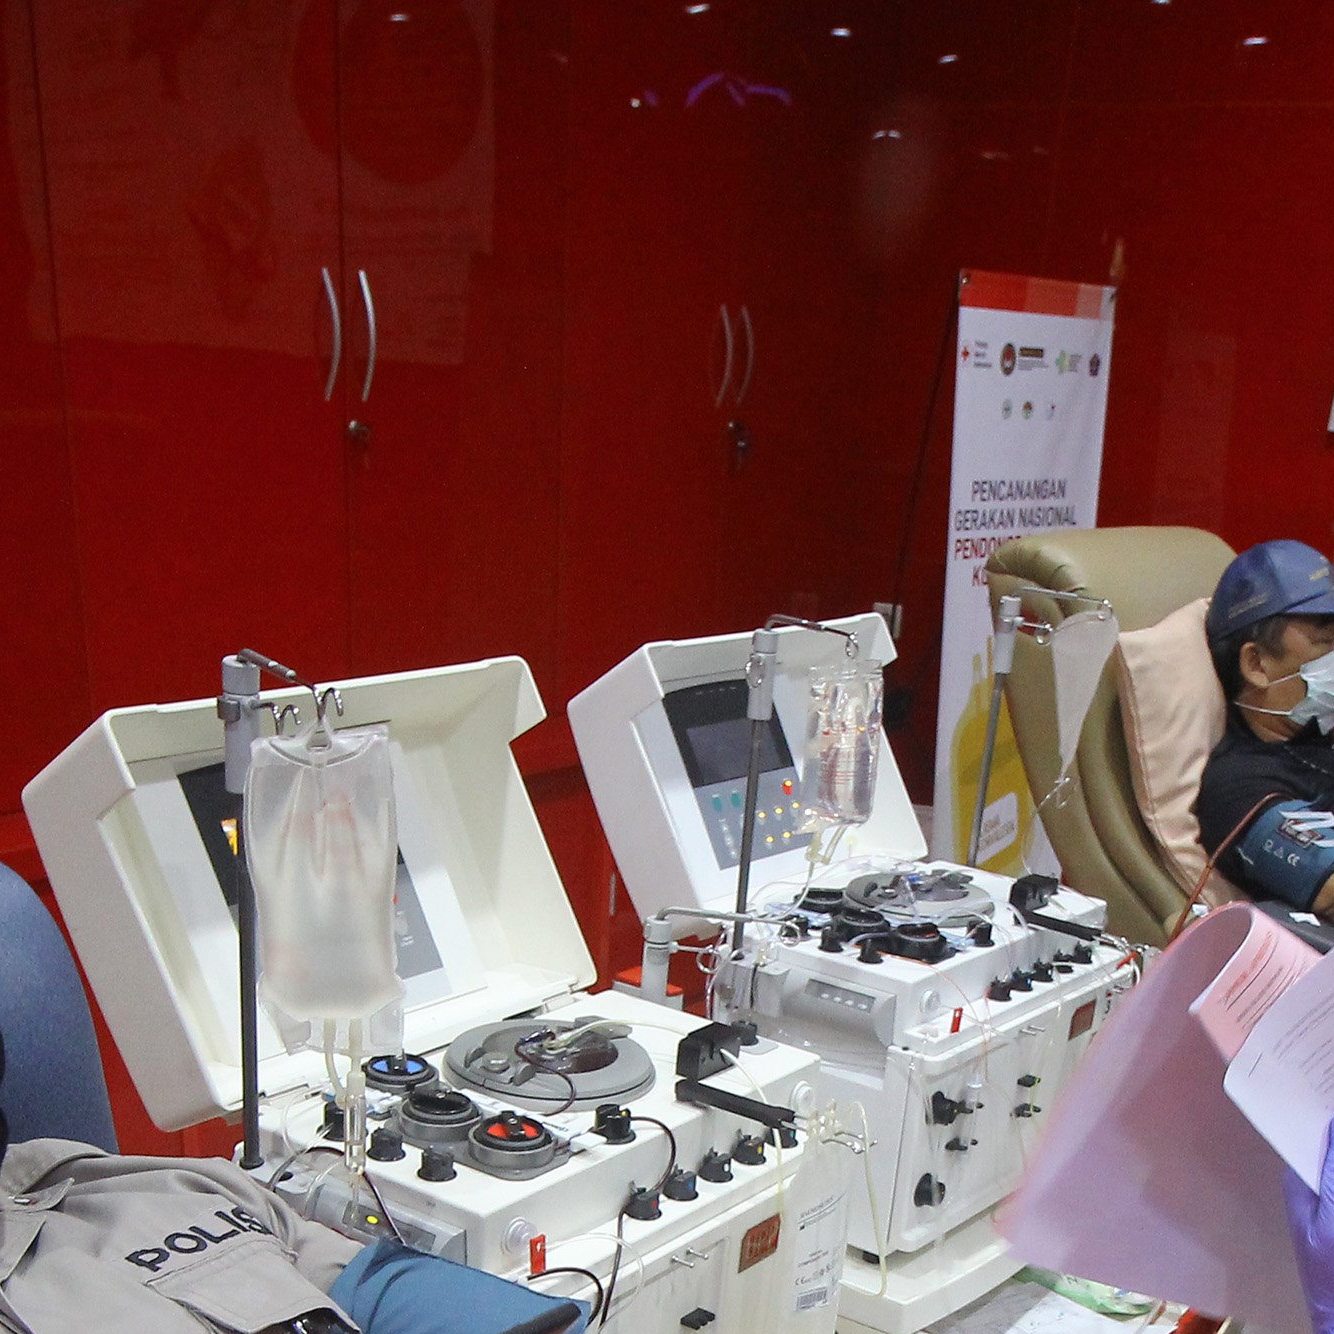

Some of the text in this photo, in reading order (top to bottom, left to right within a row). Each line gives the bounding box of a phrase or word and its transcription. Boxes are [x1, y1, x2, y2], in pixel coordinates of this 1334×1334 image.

[972, 479, 1067, 501] PENCANANGAN
[954, 504, 1077, 532] GERAKAN NASIONAL
[124, 1206, 274, 1272] POLIS
